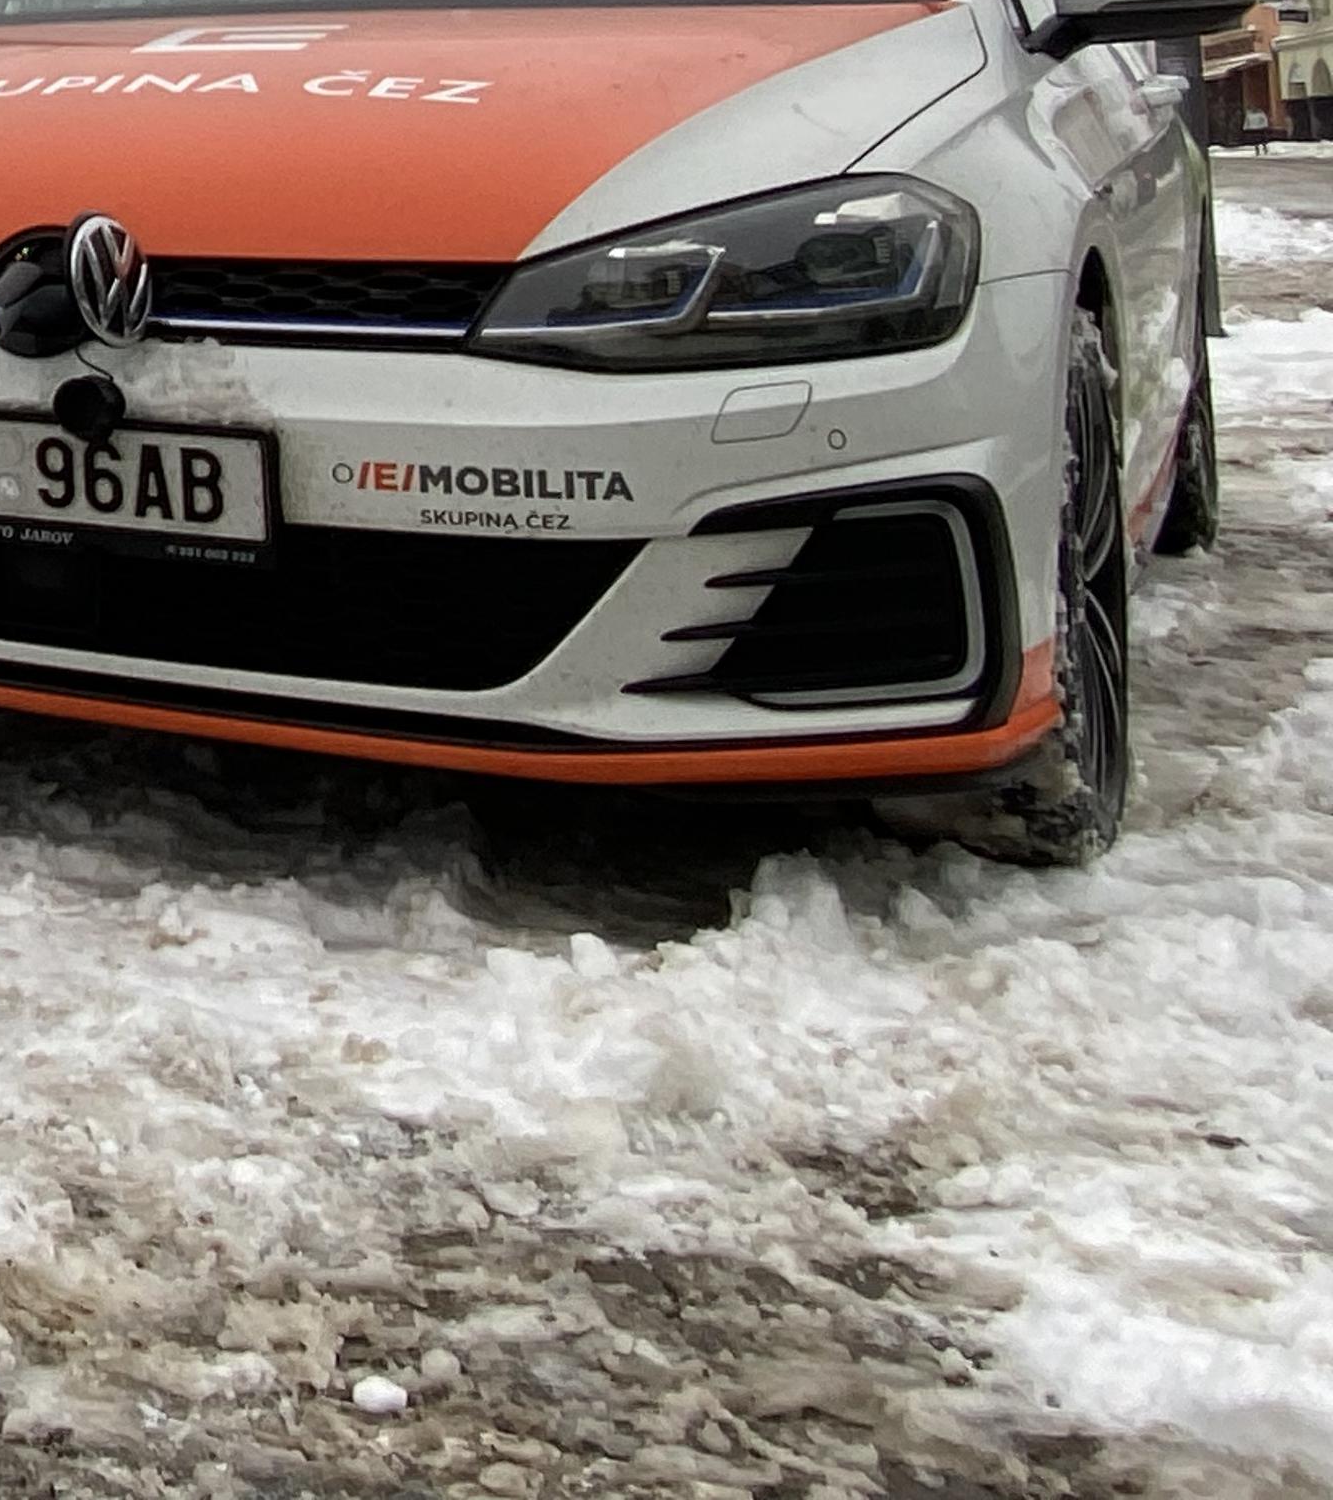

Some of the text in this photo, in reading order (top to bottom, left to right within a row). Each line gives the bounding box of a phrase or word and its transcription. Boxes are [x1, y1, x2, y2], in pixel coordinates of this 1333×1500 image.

[303, 69, 495, 104] ČEZ
[420, 509, 572, 531] SKUPINA ČEZ
